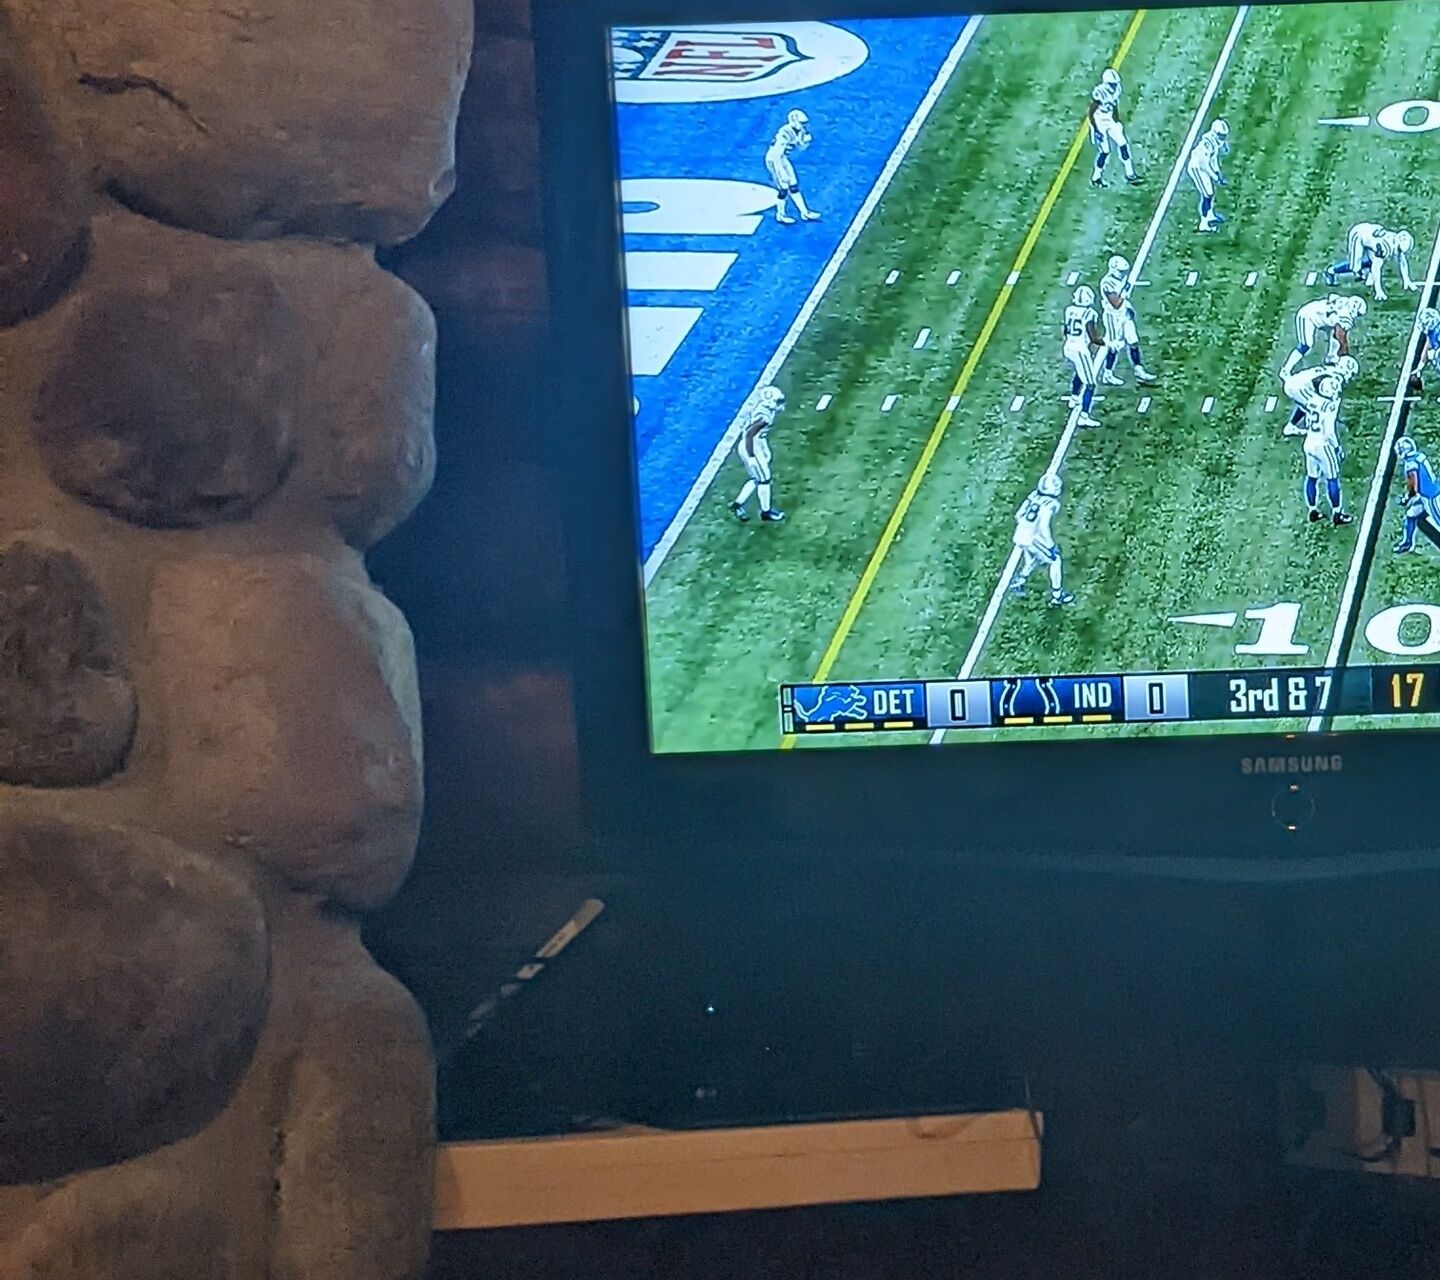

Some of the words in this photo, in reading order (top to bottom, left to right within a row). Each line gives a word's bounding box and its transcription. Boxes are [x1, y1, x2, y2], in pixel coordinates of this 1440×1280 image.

[873, 688, 915, 715] DET
[949, 688, 967, 722] 0
[1073, 682, 1113, 709] IND
[1147, 681, 1165, 715] 0
[1229, 677, 1279, 713] 3rd
[1288, 676, 1308, 712] &
[1315, 675, 1332, 711] 7
[1390, 673, 1425, 708] 17
[1240, 754, 1344, 775] SAMSUNG
